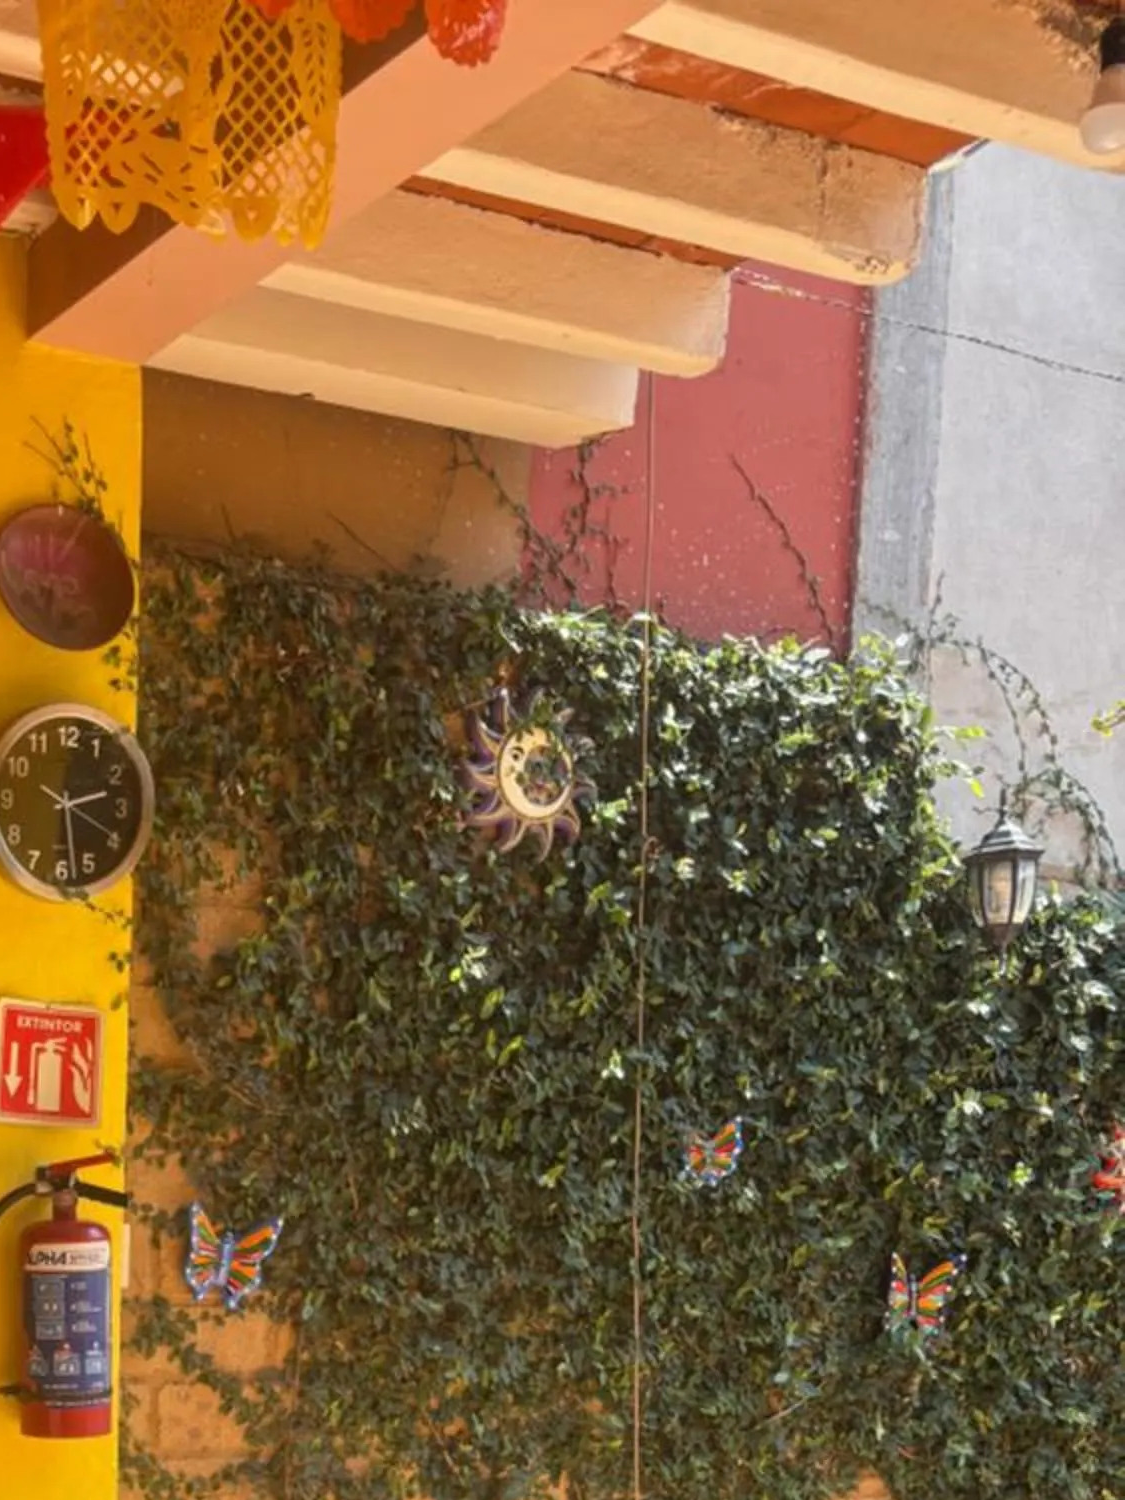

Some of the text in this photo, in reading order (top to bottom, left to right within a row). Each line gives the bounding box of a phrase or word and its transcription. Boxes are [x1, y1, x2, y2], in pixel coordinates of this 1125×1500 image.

[28, 732, 48, 755] 11
[58, 726, 80, 748] 12
[91, 738, 101, 759] 1
[7, 756, 29, 778] 10
[109, 765, 122, 785] 2
[0, 789, 13, 810] 9
[115, 799, 127, 819] 3
[7, 824, 21, 845] 8
[107, 832, 121, 849] 4
[28, 850, 41, 871] 7
[55, 861, 68, 880] 6
[82, 853, 96, 873] 5
[16, 1015, 83, 1034] EXTINTOR
